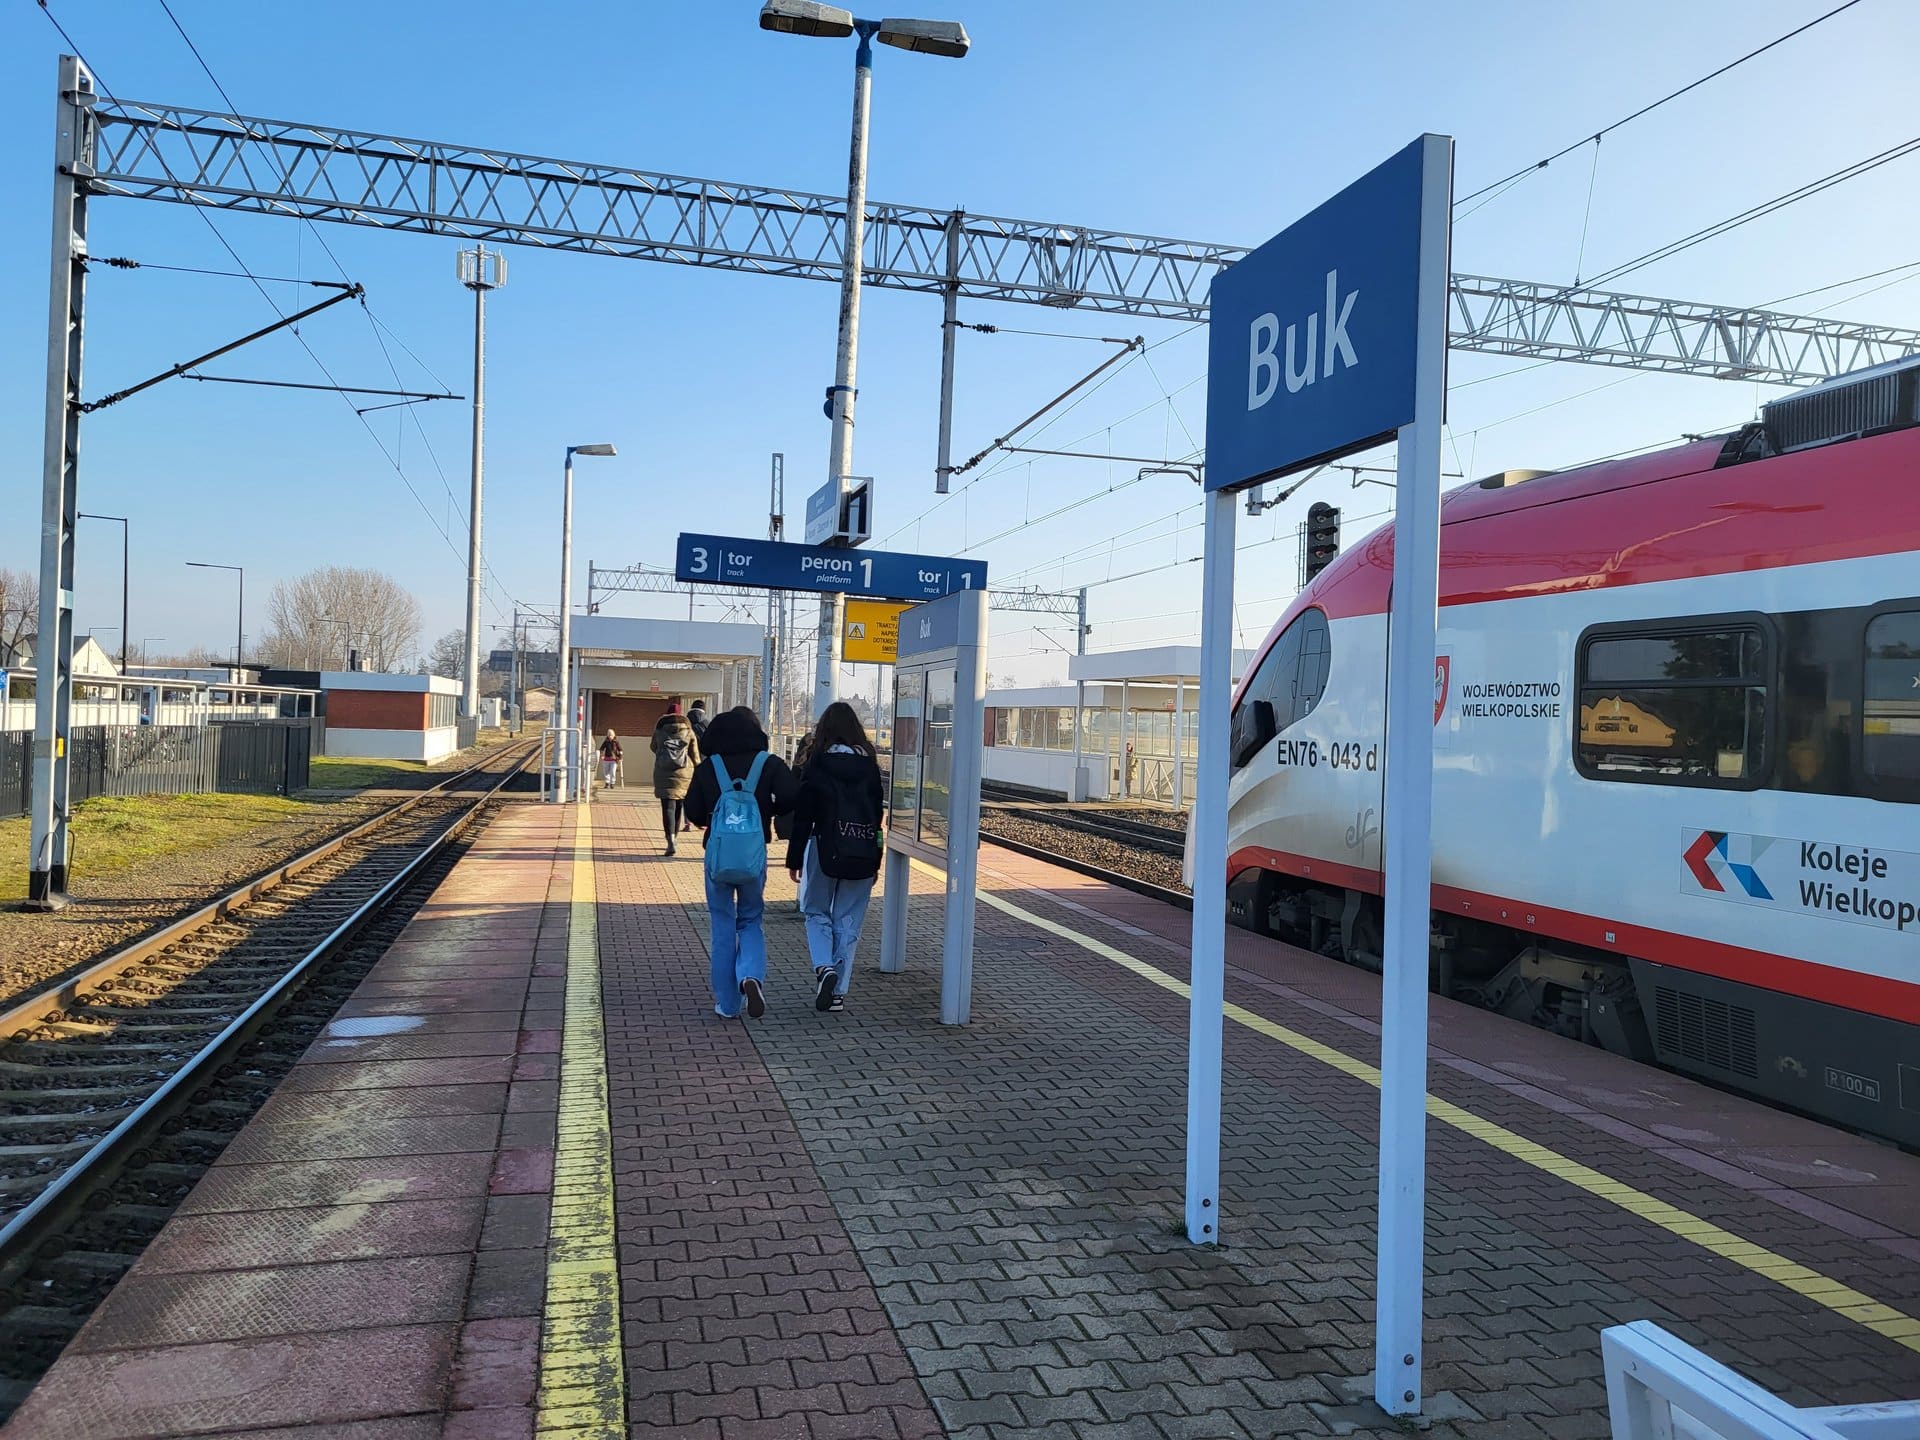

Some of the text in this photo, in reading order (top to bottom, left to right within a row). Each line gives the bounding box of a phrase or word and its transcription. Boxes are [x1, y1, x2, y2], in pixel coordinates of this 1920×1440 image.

[1247, 268, 1359, 411] Buk
[690, 547, 753, 573] 3 tor
[726, 569, 745, 577] track
[801, 556, 873, 588] peron 1
[815, 574, 852, 585] platform
[918, 568, 972, 590] tor 1
[923, 586, 940, 594] track
[1462, 681, 1560, 698] WOJEWÓDZTWO
[1461, 703, 1560, 718] WIELKOPOLSKIE
[838, 820, 875, 839] VANS
[1800, 842, 1888, 882] Koleje
[1798, 879, 1920, 931] Wielkop
